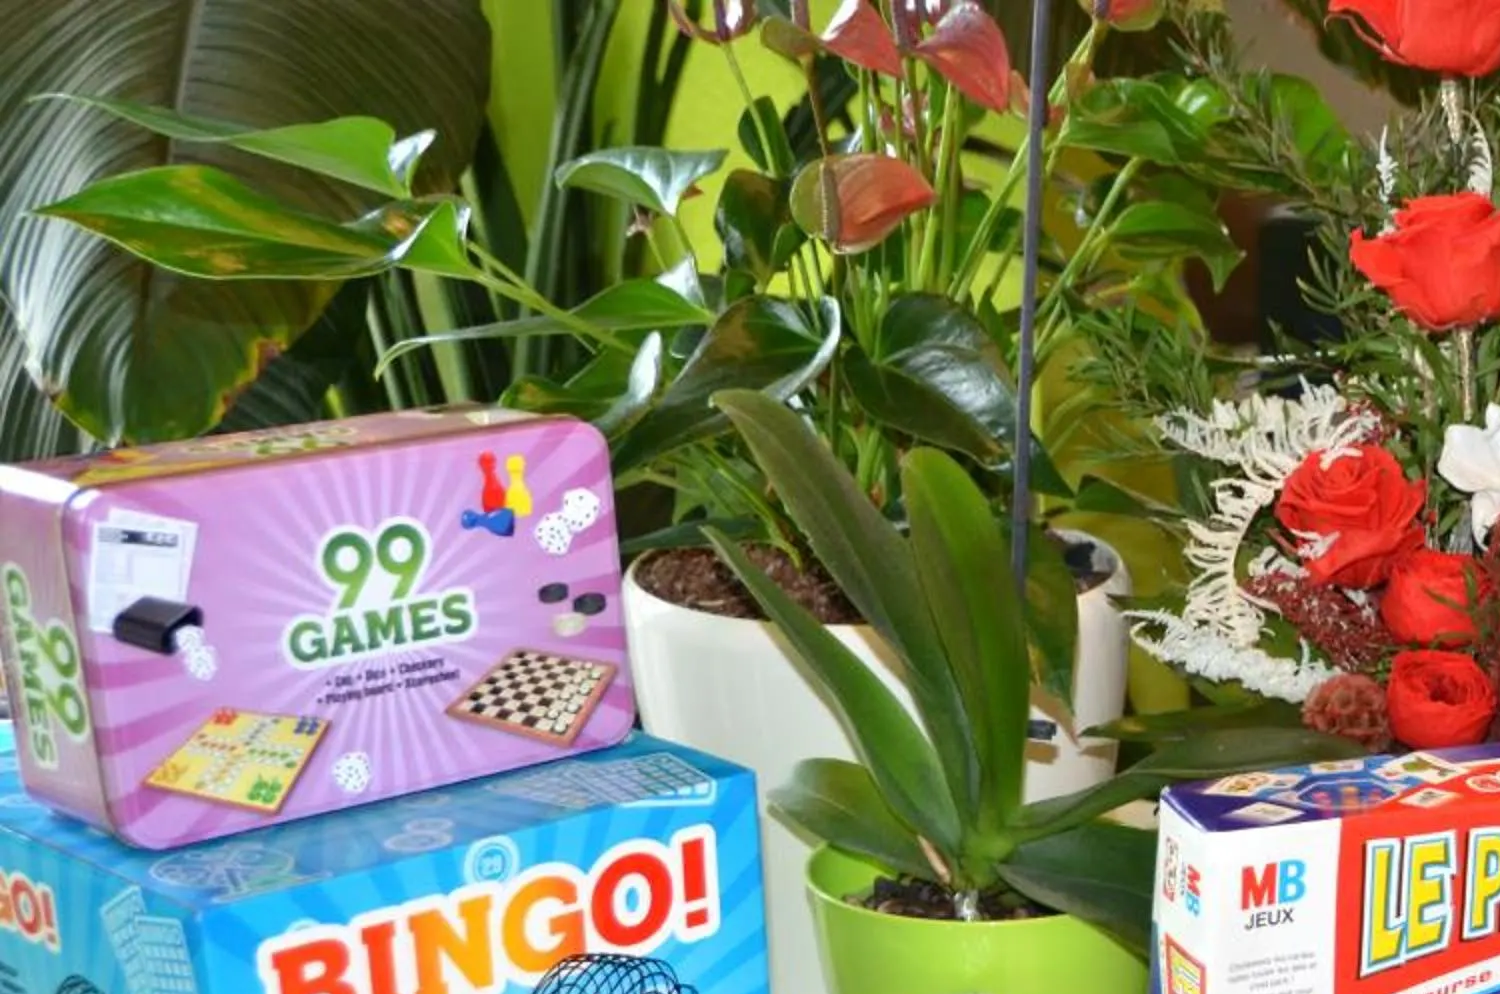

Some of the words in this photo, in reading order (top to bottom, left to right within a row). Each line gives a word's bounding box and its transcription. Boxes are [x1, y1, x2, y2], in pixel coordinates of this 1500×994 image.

[321, 522, 426, 611] 99
[6, 567, 56, 763] GAMES
[288, 592, 472, 663] GAMES
[38, 624, 87, 736] 99
[1241, 859, 1307, 910] MB
[1244, 908, 1295, 931] JEUX
[1365, 836, 1452, 970] LE
